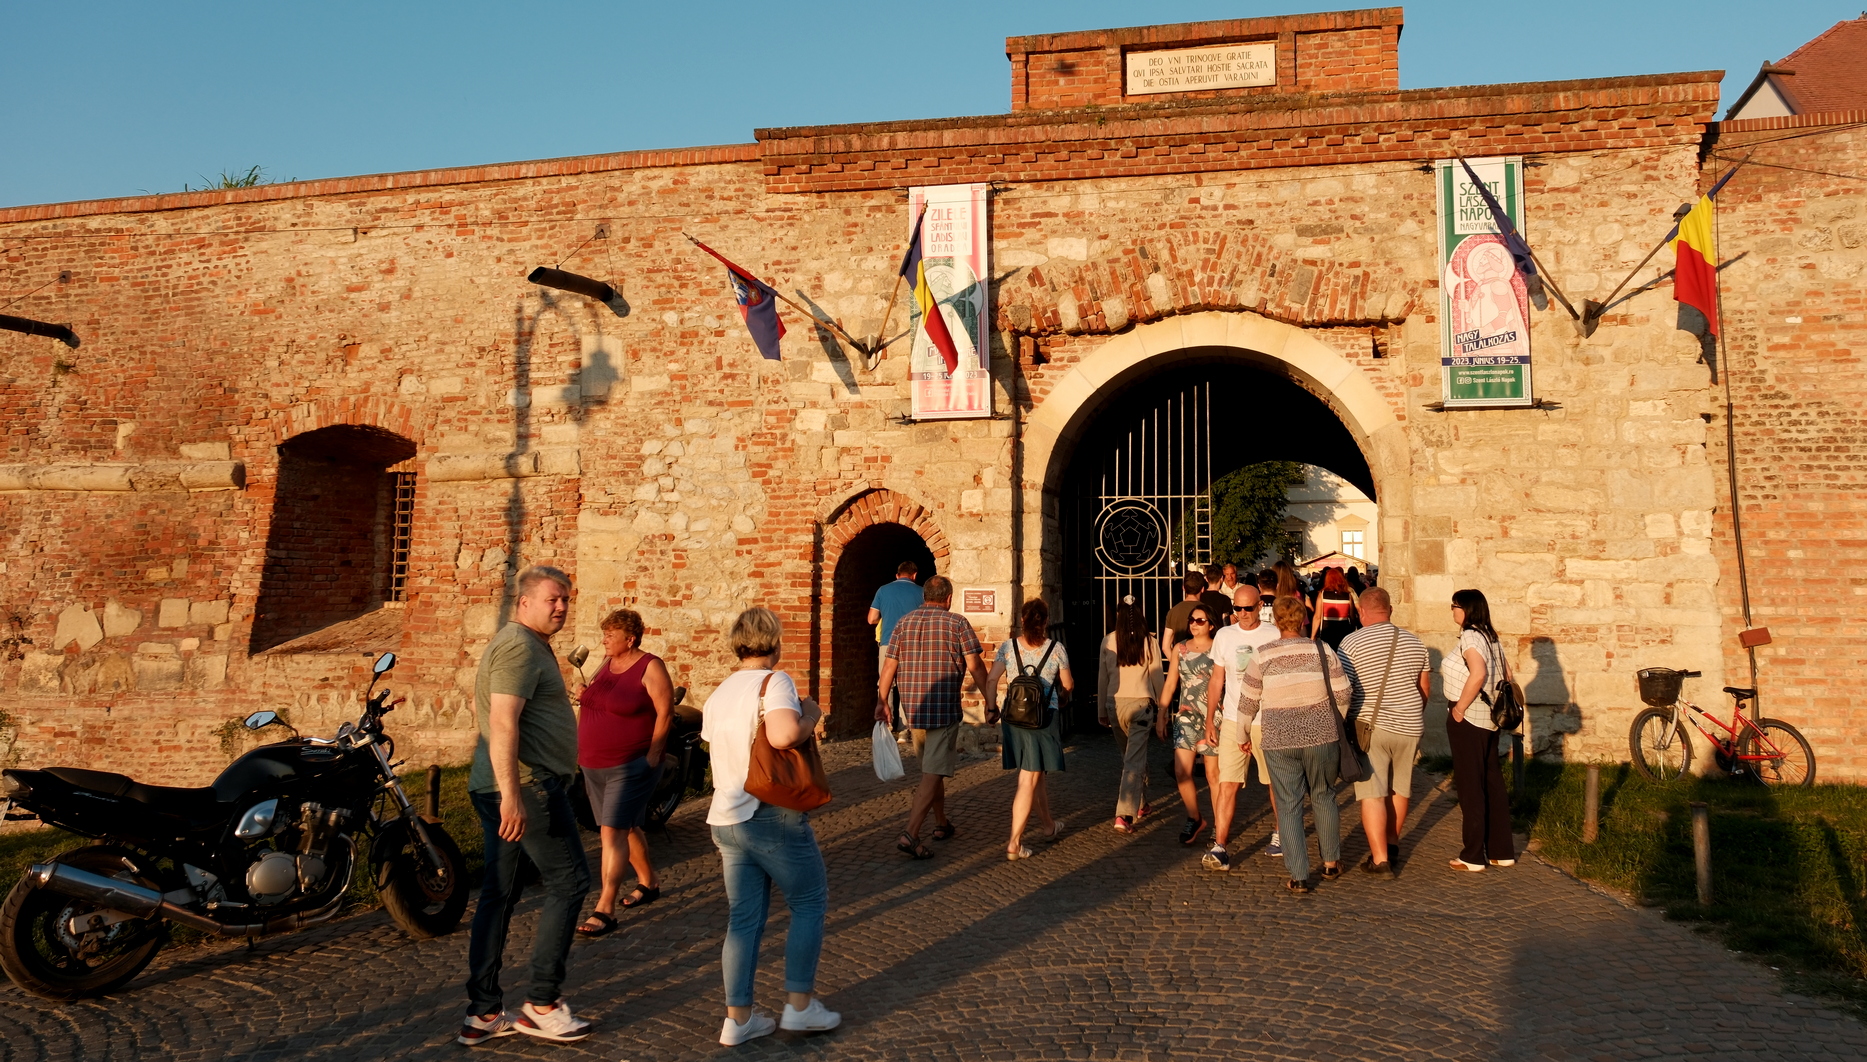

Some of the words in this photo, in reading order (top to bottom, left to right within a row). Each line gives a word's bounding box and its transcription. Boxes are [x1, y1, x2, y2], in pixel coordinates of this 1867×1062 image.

[1149, 57, 1163, 67] DEO
[1168, 55, 1181, 65] VNI
[1186, 53, 1222, 64] TRINOQVE
[1226, 51, 1252, 61] GRATIE
[1133, 69, 1146, 78] QVI
[1149, 68, 1165, 77] IPSA
[1169, 65, 1203, 76] SALVTARI
[1207, 63, 1232, 73] HOSTIE
[1236, 60, 1268, 71] SACRATA
[1143, 78, 1155, 88] DIE
[1158, 77, 1180, 87] OSTIA
[1184, 74, 1219, 85] APERUVIT
[1223, 71, 1259, 82] VARADINI
[1459, 195, 1501, 208] LÁSZ
[1460, 207, 1493, 221] NAPO
[1457, 331, 1479, 344] NAGY
[1464, 331, 1515, 353] TALÁLKOZÁS
[1451, 357, 1472, 365] 2023.
[1472, 355, 1495, 366] JÚNIUS
